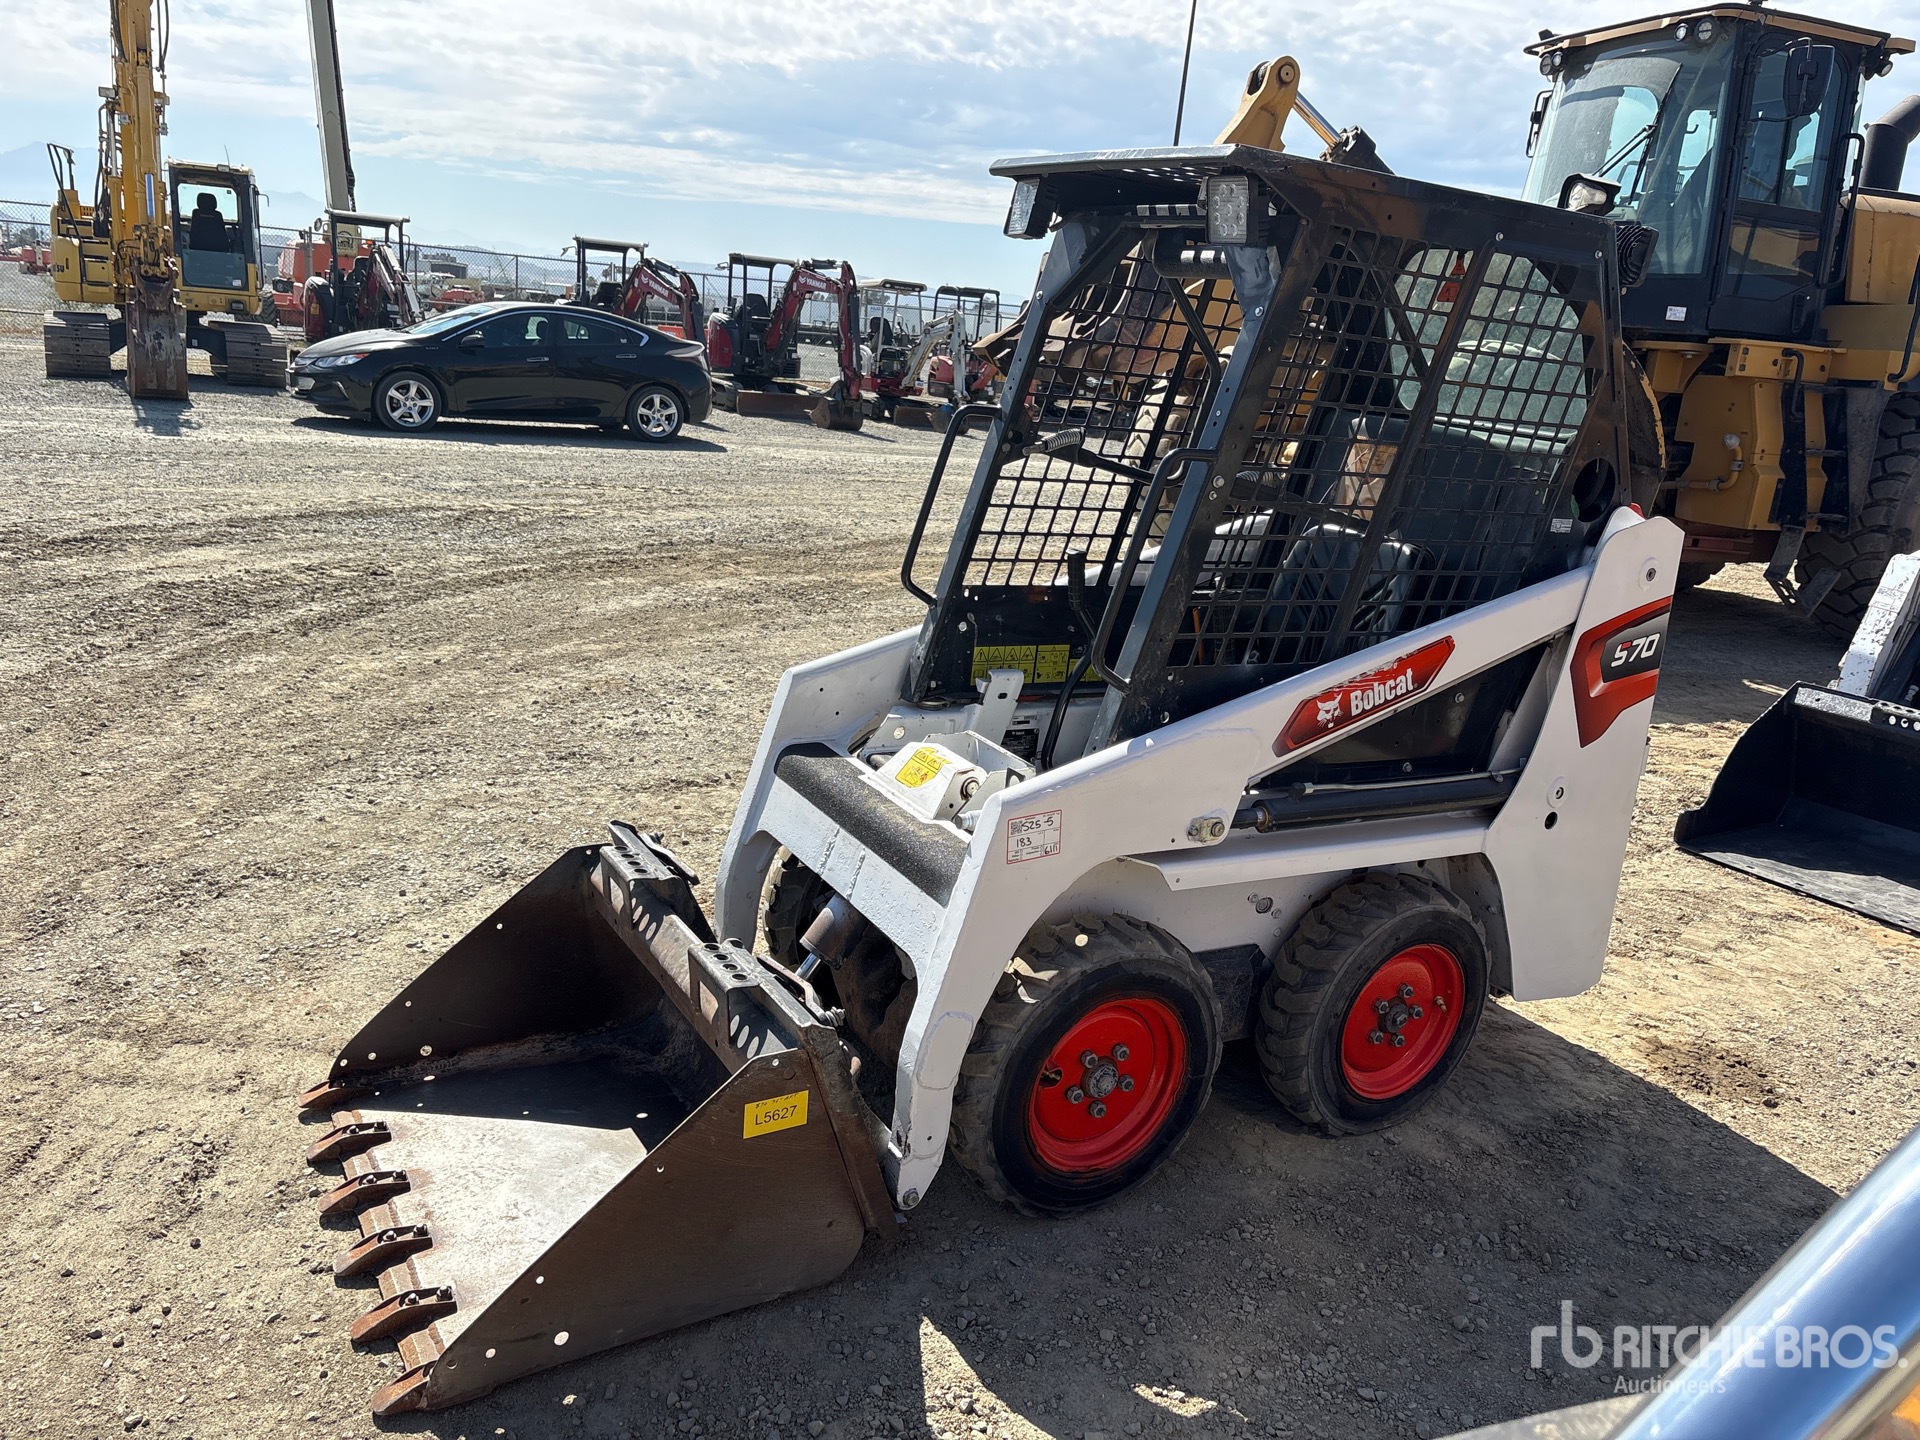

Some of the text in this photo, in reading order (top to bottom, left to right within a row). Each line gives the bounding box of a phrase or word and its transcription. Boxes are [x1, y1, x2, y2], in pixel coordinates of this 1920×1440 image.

[648, 278, 669, 298] YANMAR
[805, 277, 827, 290] YANMAR
[1610, 632, 1661, 668] S70
[1350, 668, 1414, 716] Bobcat
[1016, 836, 1033, 848] 183
[755, 1105, 798, 1126] L5627
